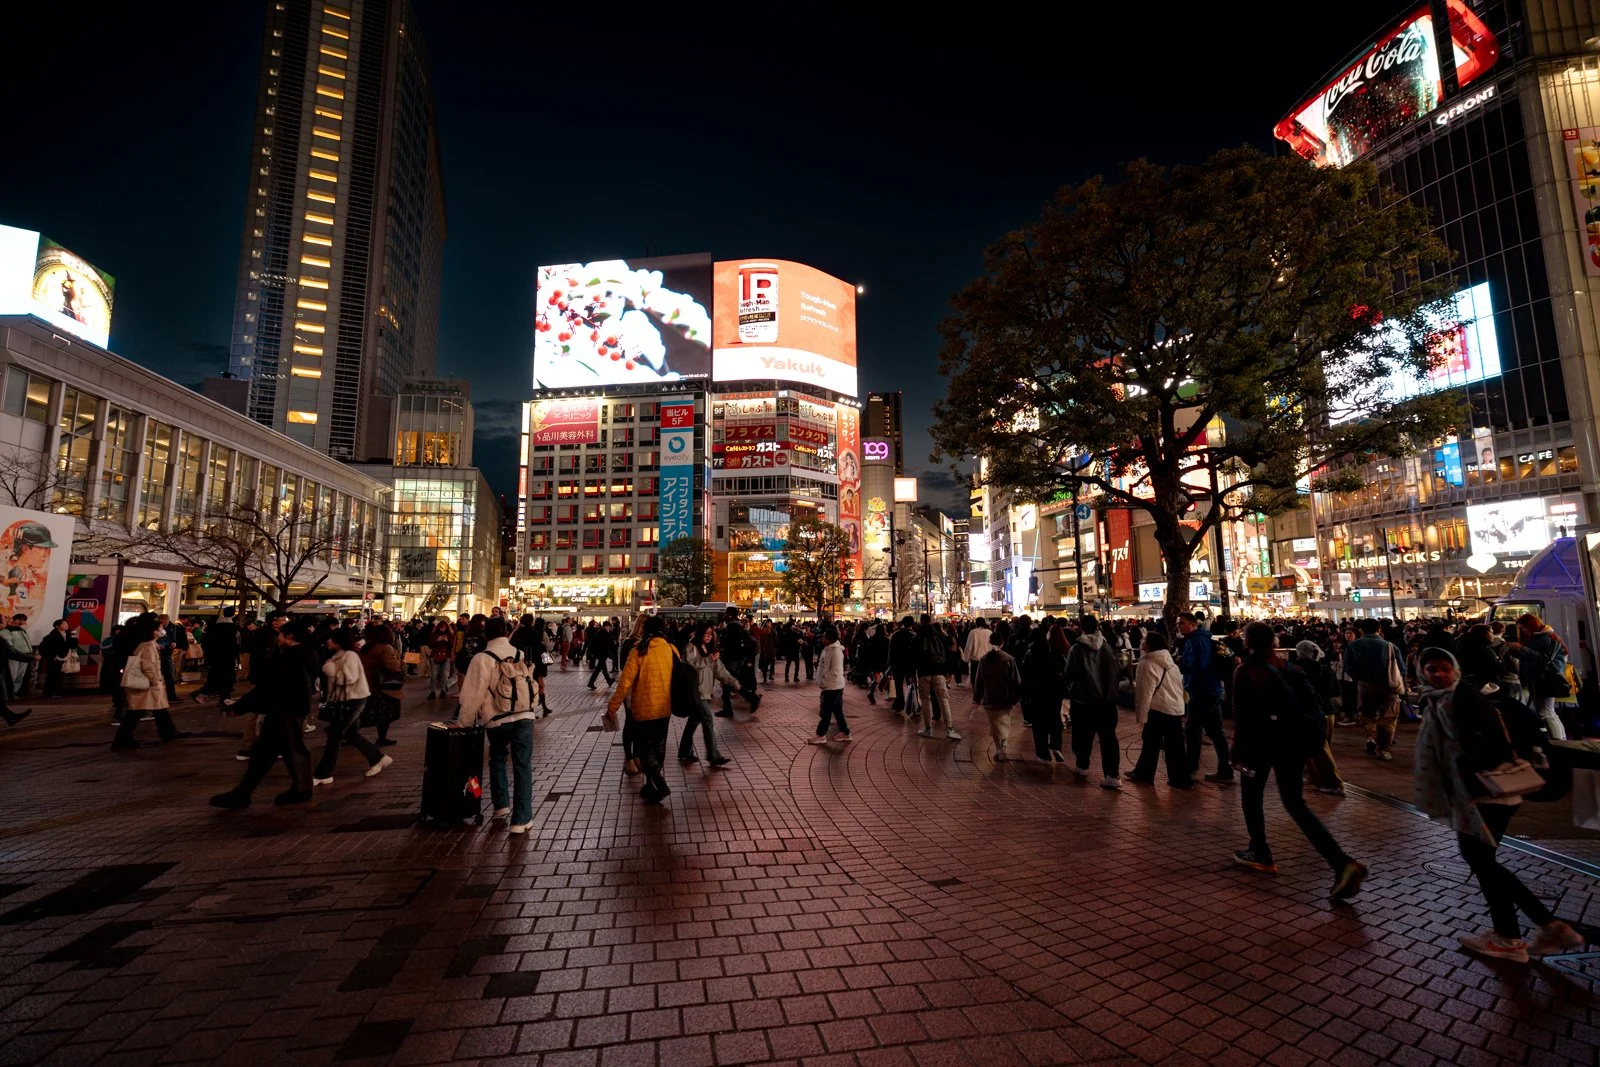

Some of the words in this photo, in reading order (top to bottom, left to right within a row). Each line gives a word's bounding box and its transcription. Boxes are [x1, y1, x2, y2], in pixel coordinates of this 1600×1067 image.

[1436, 86, 1495, 125] QFRONT
[760, 356, 825, 377] Yakult
[562, 412, 592, 420] クリニック
[666, 408, 688, 417] 当ビル
[671, 418, 683, 426] 5F
[542, 430, 594, 441] 品川美容外科
[790, 427, 827, 442] コンタクト
[756, 442, 780, 452] ガスト
[817, 447, 834, 459] ガスト
[864, 442, 889, 460] 109
[714, 458, 724, 466] 7F
[742, 456, 771, 467] ガスト
[662, 477, 677, 541] アイシティ
[1341, 550, 1441, 570] STARBUCKS
[553, 585, 608, 597] サンドラッグ
